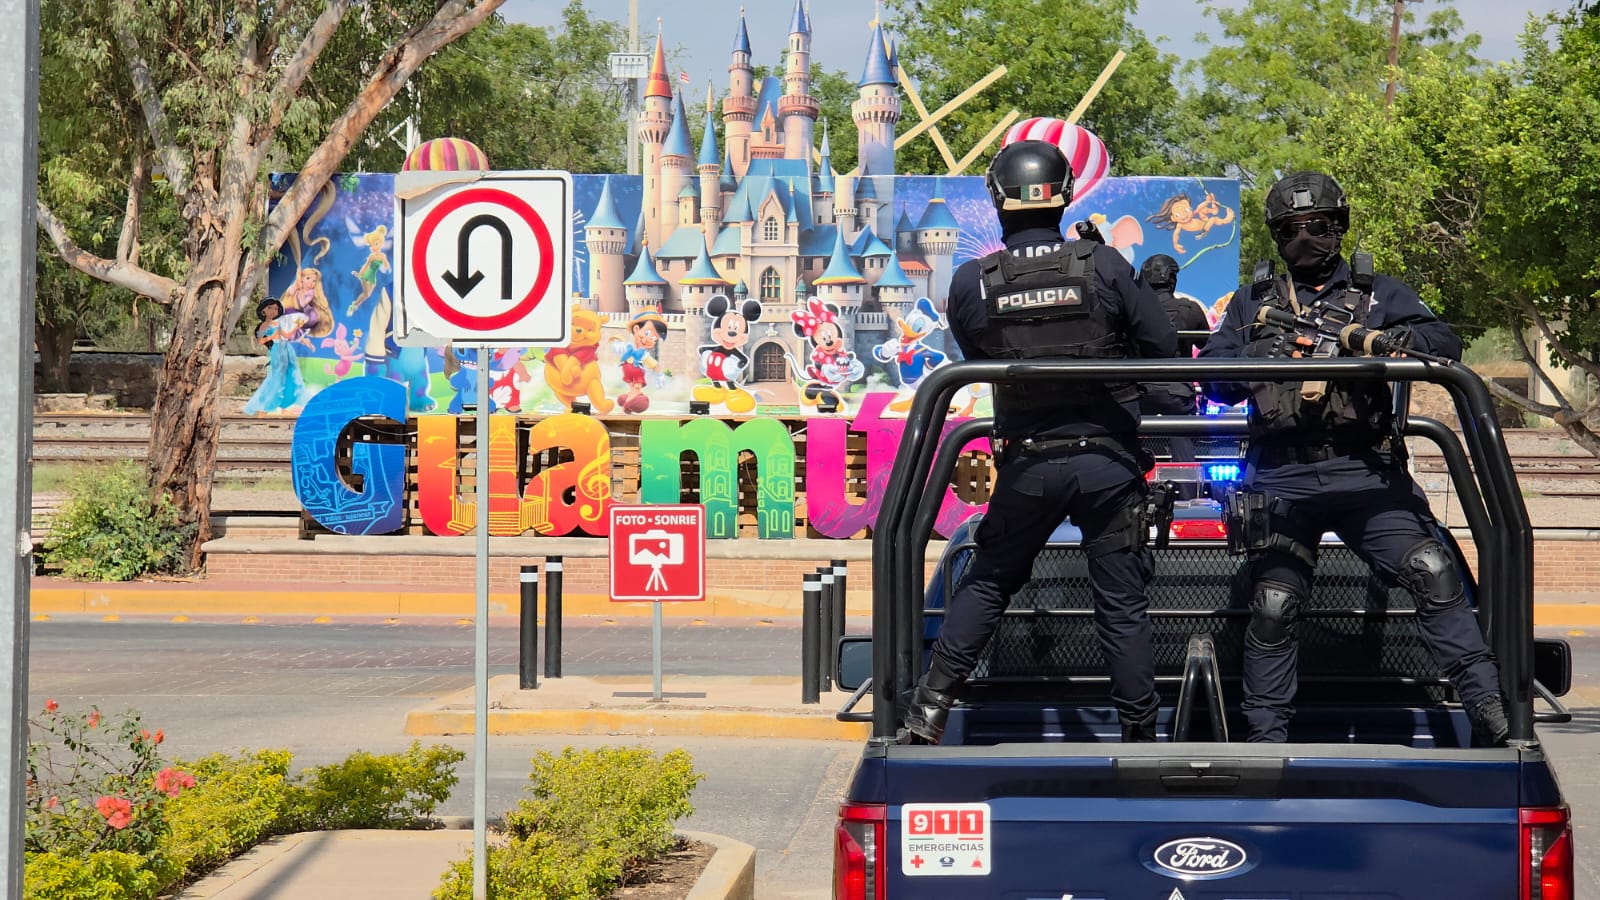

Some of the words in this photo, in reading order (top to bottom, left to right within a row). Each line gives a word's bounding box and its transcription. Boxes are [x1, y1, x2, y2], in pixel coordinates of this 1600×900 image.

[998, 289, 1078, 308] POLICIA
[616, 515, 646, 525] FOTO
[654, 515, 697, 525] SONRIE
[913, 813, 976, 832] 911
[909, 843, 984, 852] EMERGENCIAS
[1170, 843, 1229, 868] Ford
